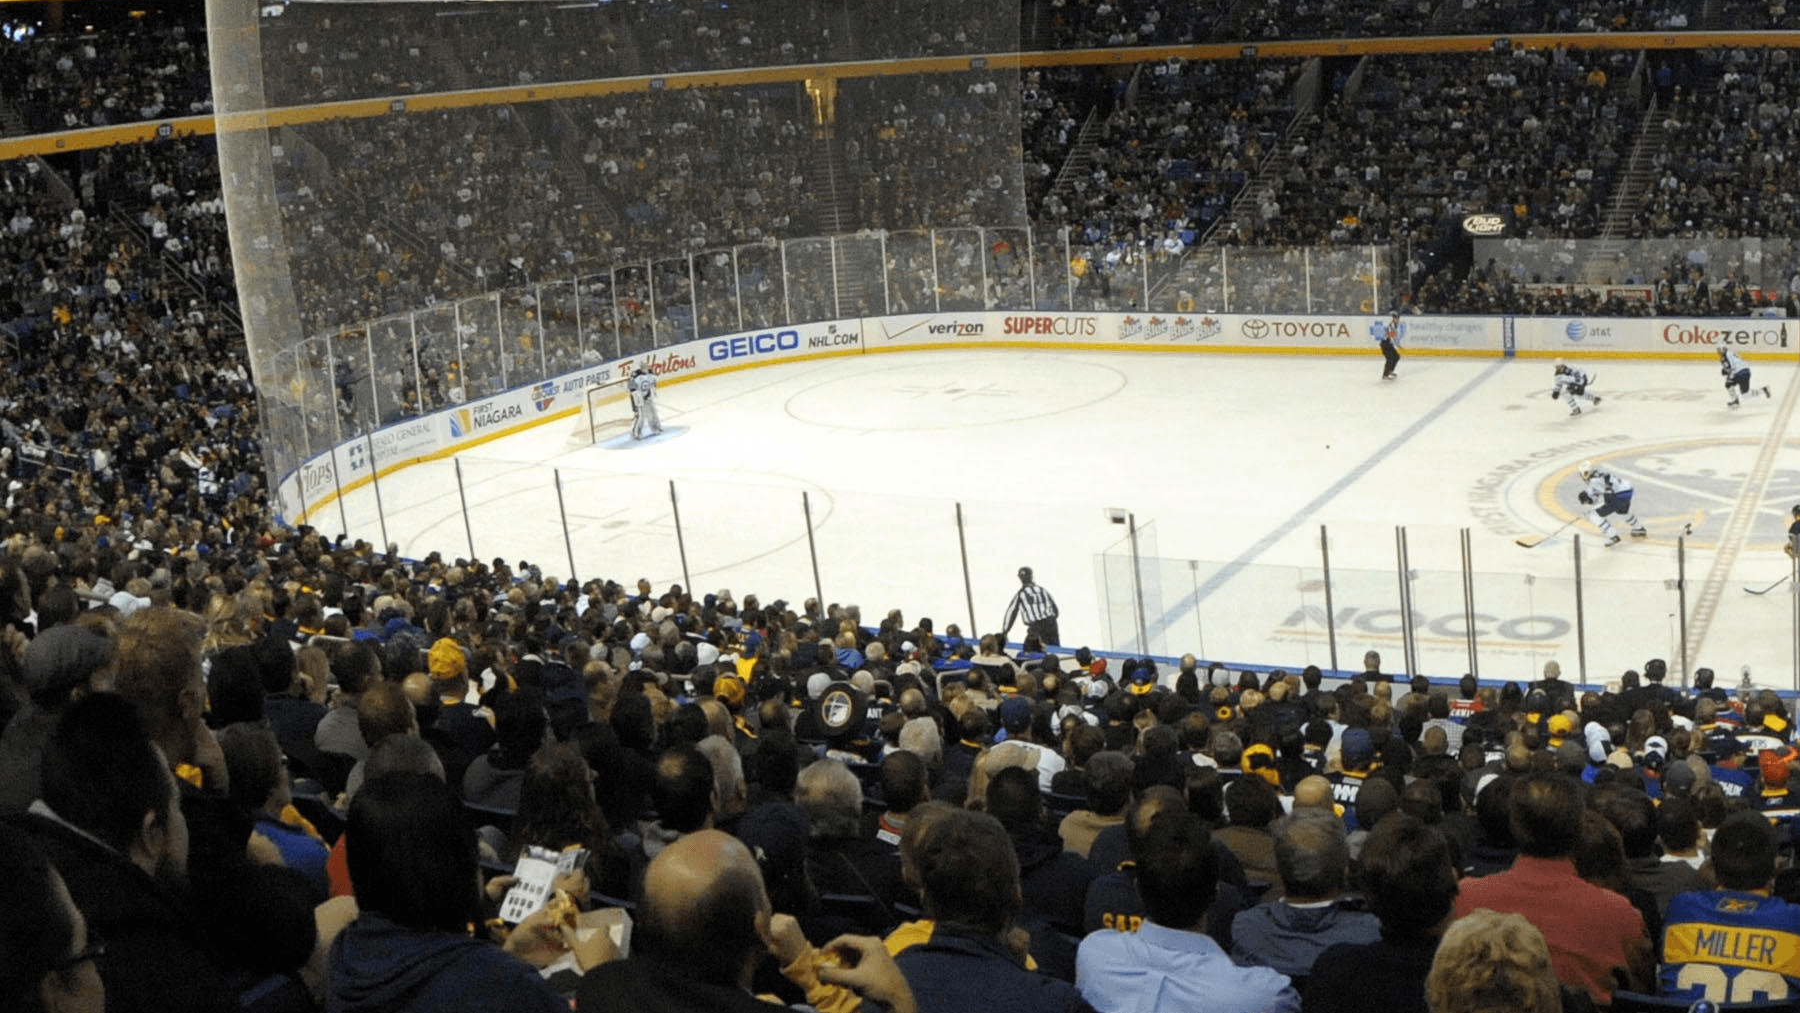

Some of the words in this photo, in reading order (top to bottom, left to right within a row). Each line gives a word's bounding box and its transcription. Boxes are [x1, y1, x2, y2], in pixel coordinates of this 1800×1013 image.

[928, 321, 984, 336] verizon
[1004, 316, 1096, 335] SUPERCUTS
[1272, 322, 1350, 338] TOYOTA
[709, 330, 800, 361] GEICO
[808, 333, 858, 349] NHL.COM
[563, 377, 584, 392] AUTO
[586, 370, 610, 385] PARTS
[473, 402, 493, 414] FIRST
[473, 404, 522, 429] NIAGARA
[1280, 604, 1570, 641] NOCO
[1694, 928, 1777, 965] MILLER
